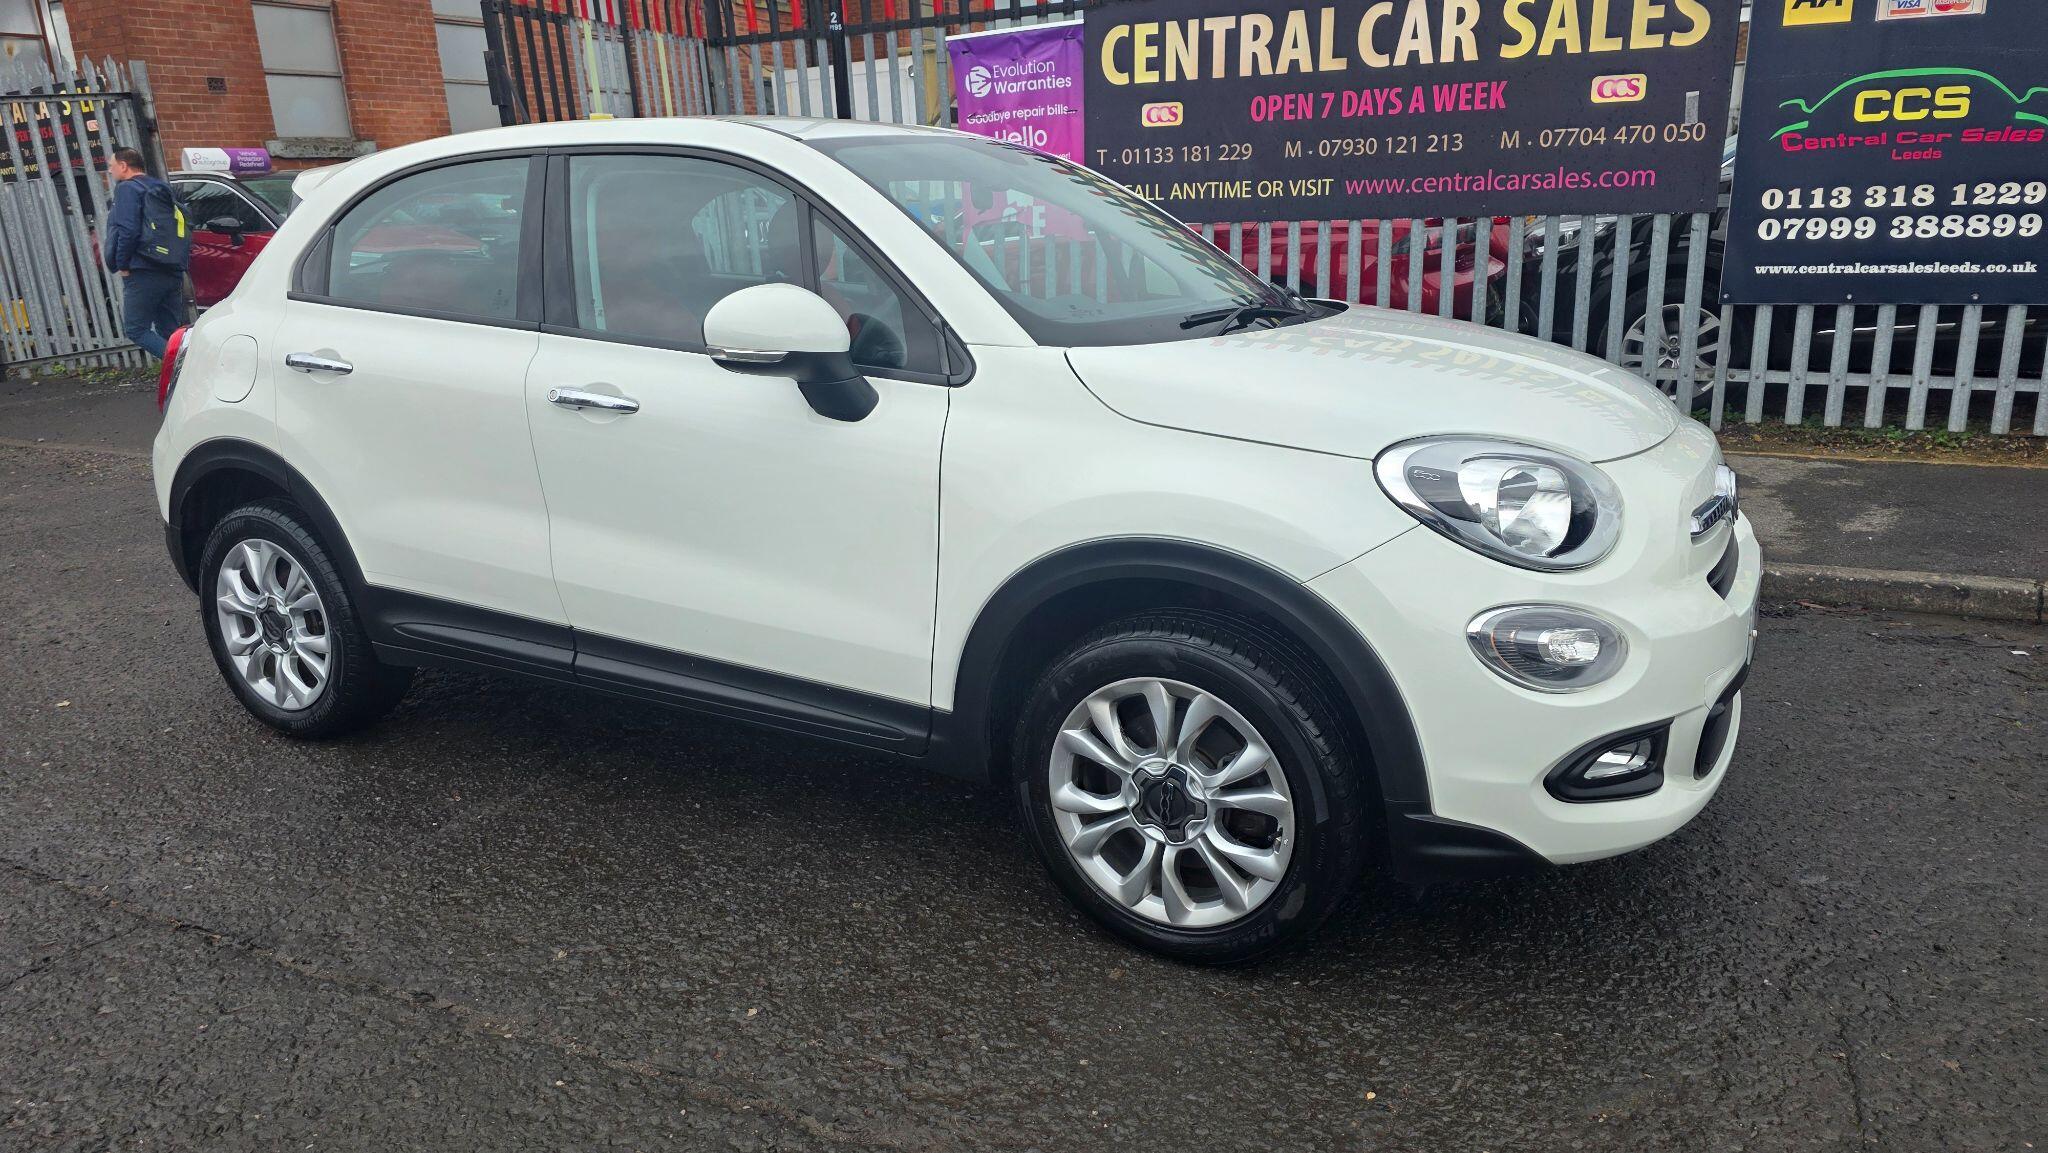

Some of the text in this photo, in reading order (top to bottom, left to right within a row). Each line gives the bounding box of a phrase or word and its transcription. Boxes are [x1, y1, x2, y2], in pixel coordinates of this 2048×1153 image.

[830, 12, 837, 23] 2
[1101, 0, 1711, 85] CENTRAL CAR SALES
[993, 60, 1055, 78] Evolution
[994, 75, 1071, 94] Warranties
[1597, 77, 1640, 98] CCS
[1251, 81, 1508, 122] OPEN 7 DAYS A WEEK
[1854, 85, 1971, 122] CCS
[967, 109, 1010, 124] Goodbye
[1013, 106, 1044, 120] repair
[1146, 105, 1178, 123] CCS
[1122, 147, 1174, 164] 01133
[1183, 145, 1210, 162] 181
[1219, 143, 1252, 161] 229
[1319, 138, 1378, 157] 07930
[1385, 135, 1418, 154] 121
[1427, 133, 1463, 153] 213
[1540, 127, 1606, 148] 07704
[1613, 124, 1655, 144] 470
[1663, 122, 1706, 143] 050
[1781, 126, 2045, 151] Central Car Sales
[1891, 148, 1943, 160] Leeds
[1170, 180, 1251, 199] ANYTIME
[1257, 180, 1283, 198] OR
[1288, 178, 1334, 196] VISIT
[1345, 166, 1656, 195] www.centralcarsales.com
[1761, 181, 2047, 210] 0113 318 1229
[1757, 213, 2043, 241] 07999 388899
[1755, 261, 2038, 275] www.centralcarsalesleeds.co.uk
